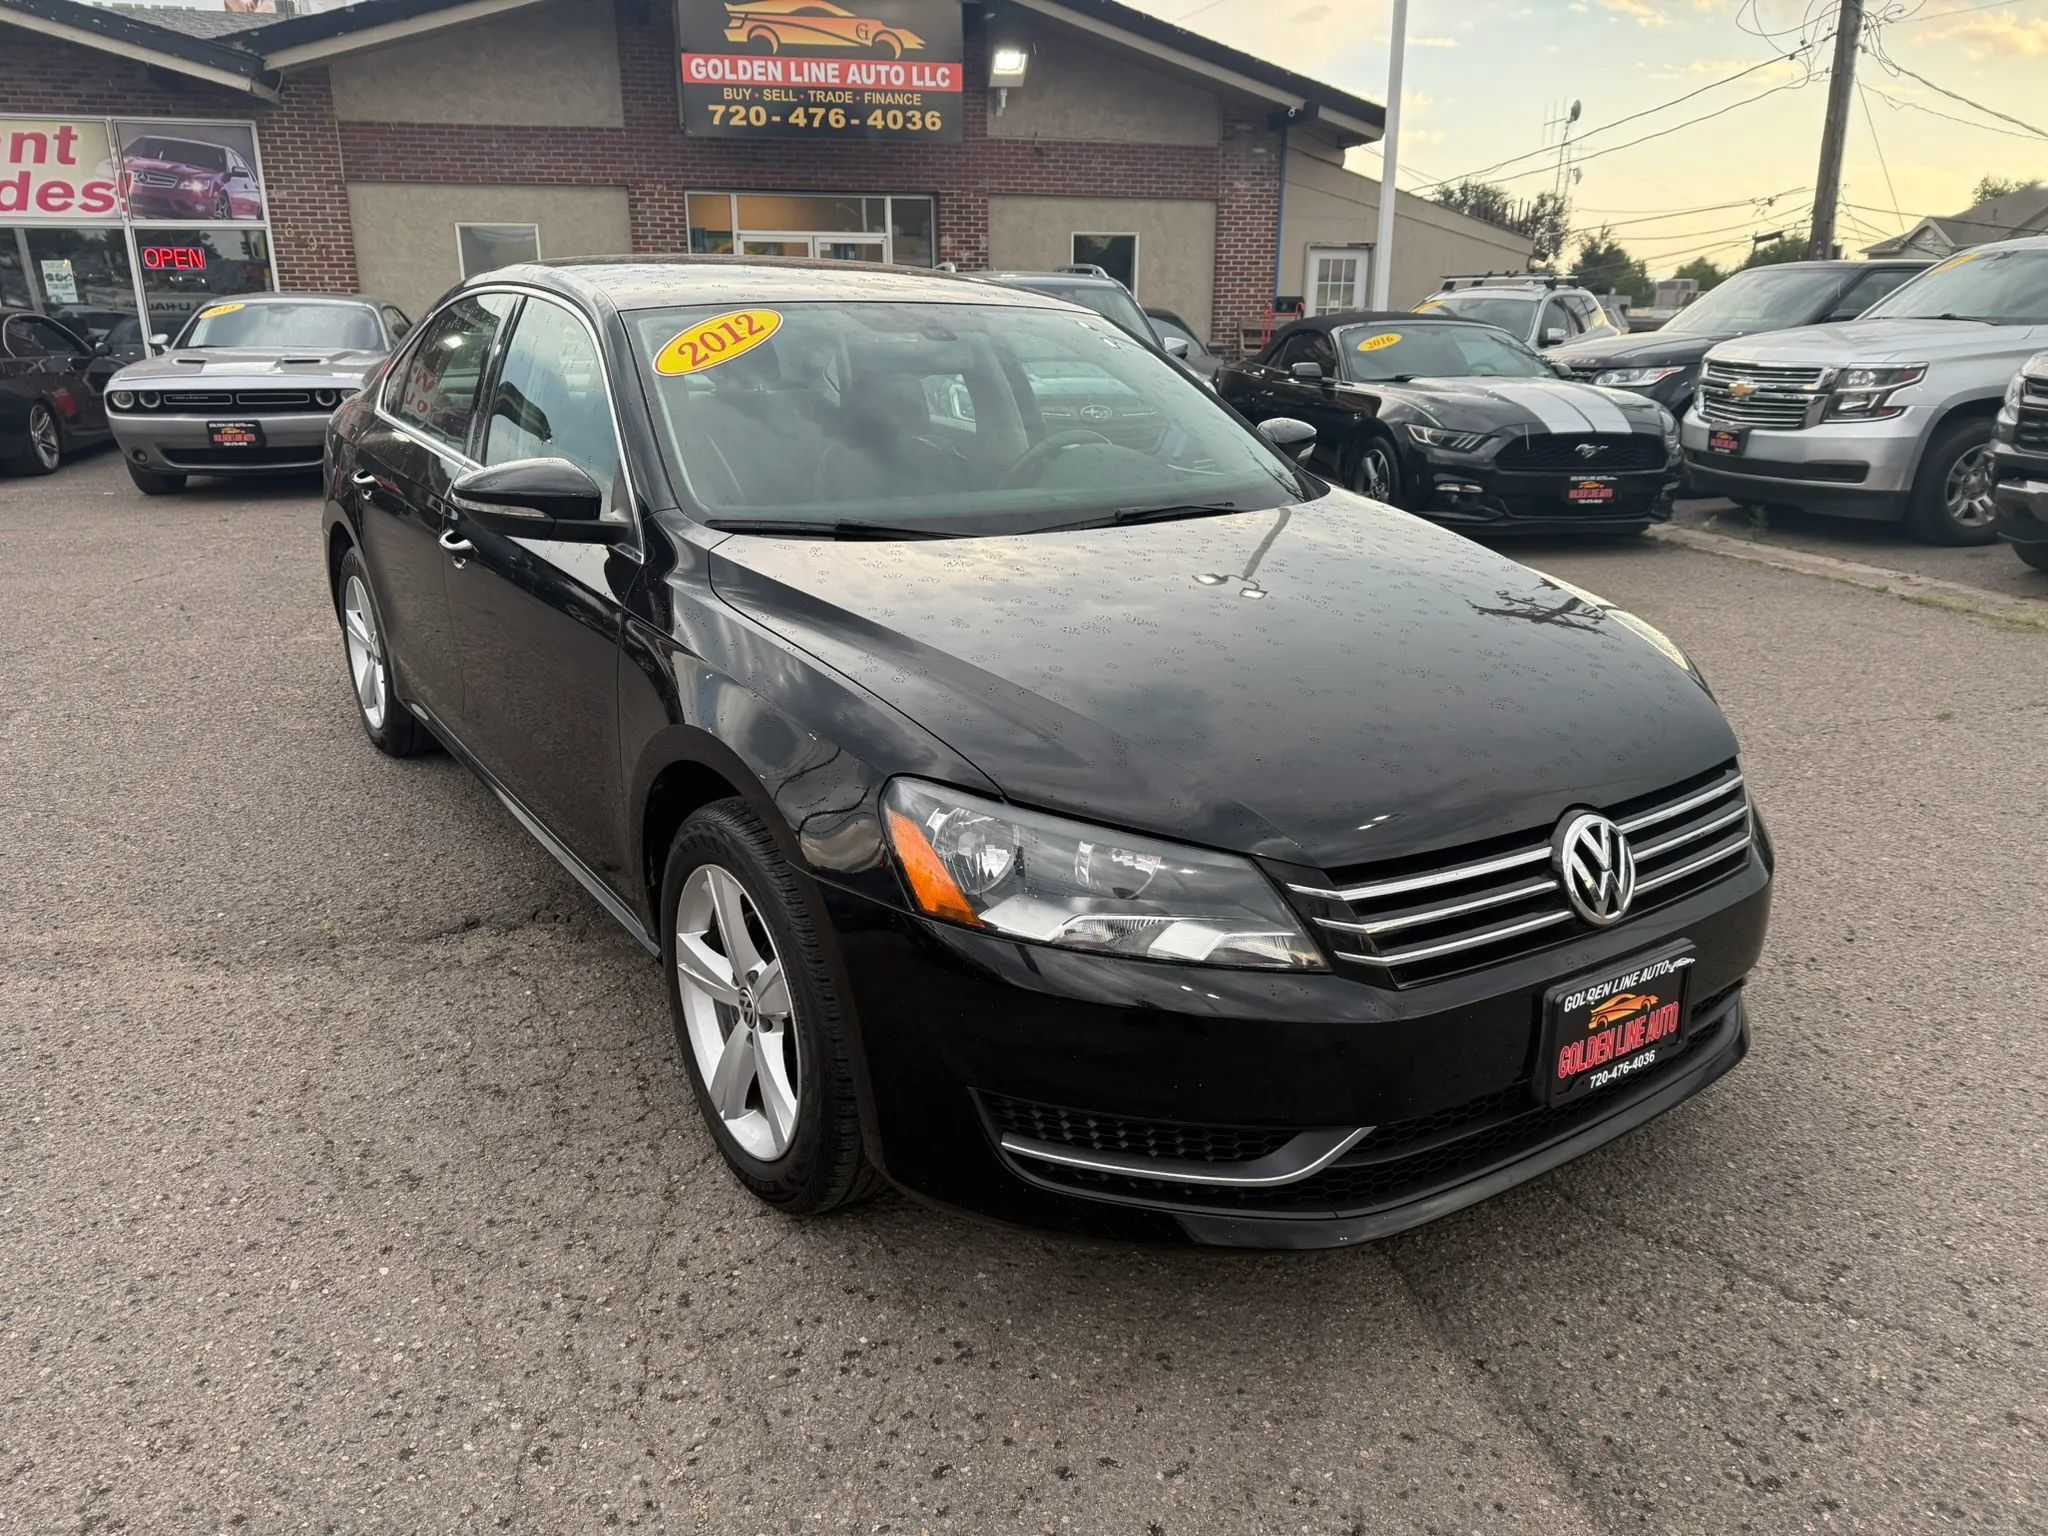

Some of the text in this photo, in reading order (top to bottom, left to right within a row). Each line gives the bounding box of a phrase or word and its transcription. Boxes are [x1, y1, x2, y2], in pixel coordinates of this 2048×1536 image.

[690, 57, 951, 88] GOLDEN LINE AUTO LLC
[723, 87, 922, 105] BUY SELL TRADE FINANCE
[0, 125, 78, 165] nt
[143, 248, 204, 270] OPEN
[678, 314, 765, 367] 2012
[1367, 335, 1394, 349] 2016
[1564, 960, 1669, 1013] GOLDEN LINE AUTO
[1558, 1001, 1679, 1078] GOLDEN LINE AUTO
[1590, 1050, 1656, 1089] 720-476-4036
